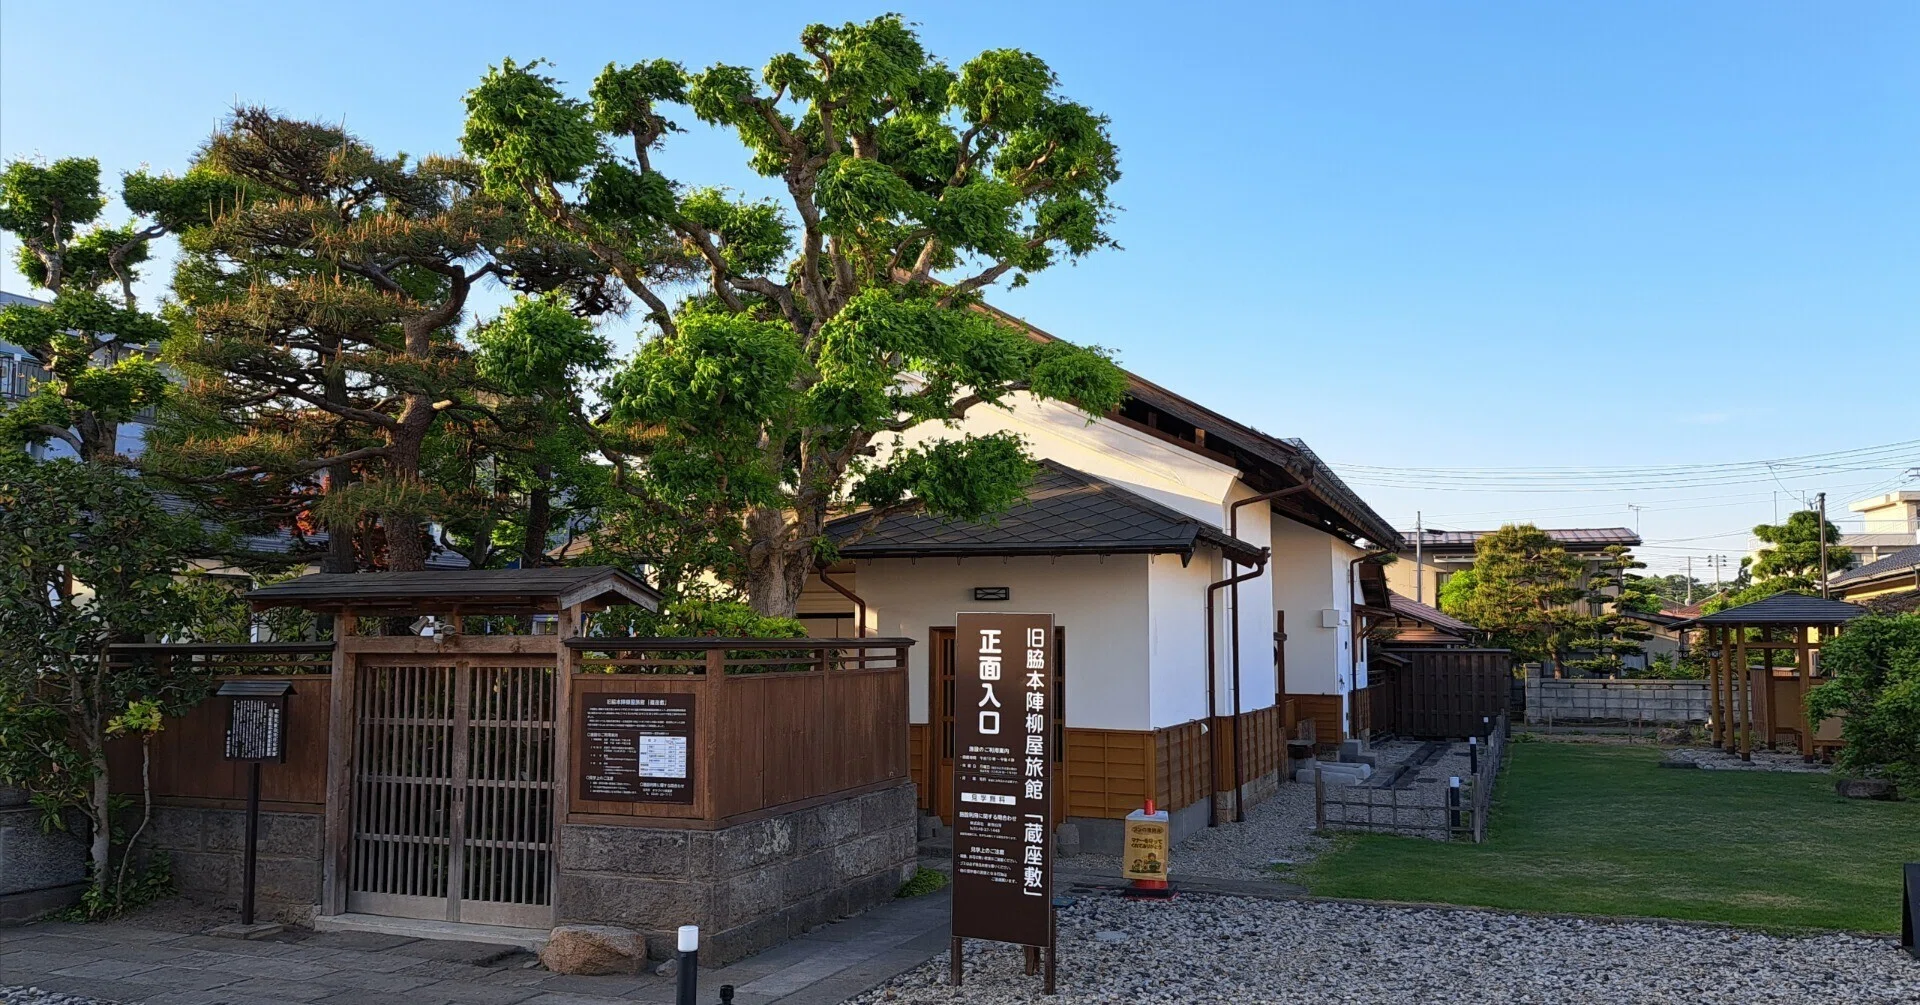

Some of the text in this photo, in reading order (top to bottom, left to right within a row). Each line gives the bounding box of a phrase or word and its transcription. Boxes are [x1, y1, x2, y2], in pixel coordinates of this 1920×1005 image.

[978, 629, 1002, 734] 正面入口
[971, 793, 1006, 803] 見学無料
